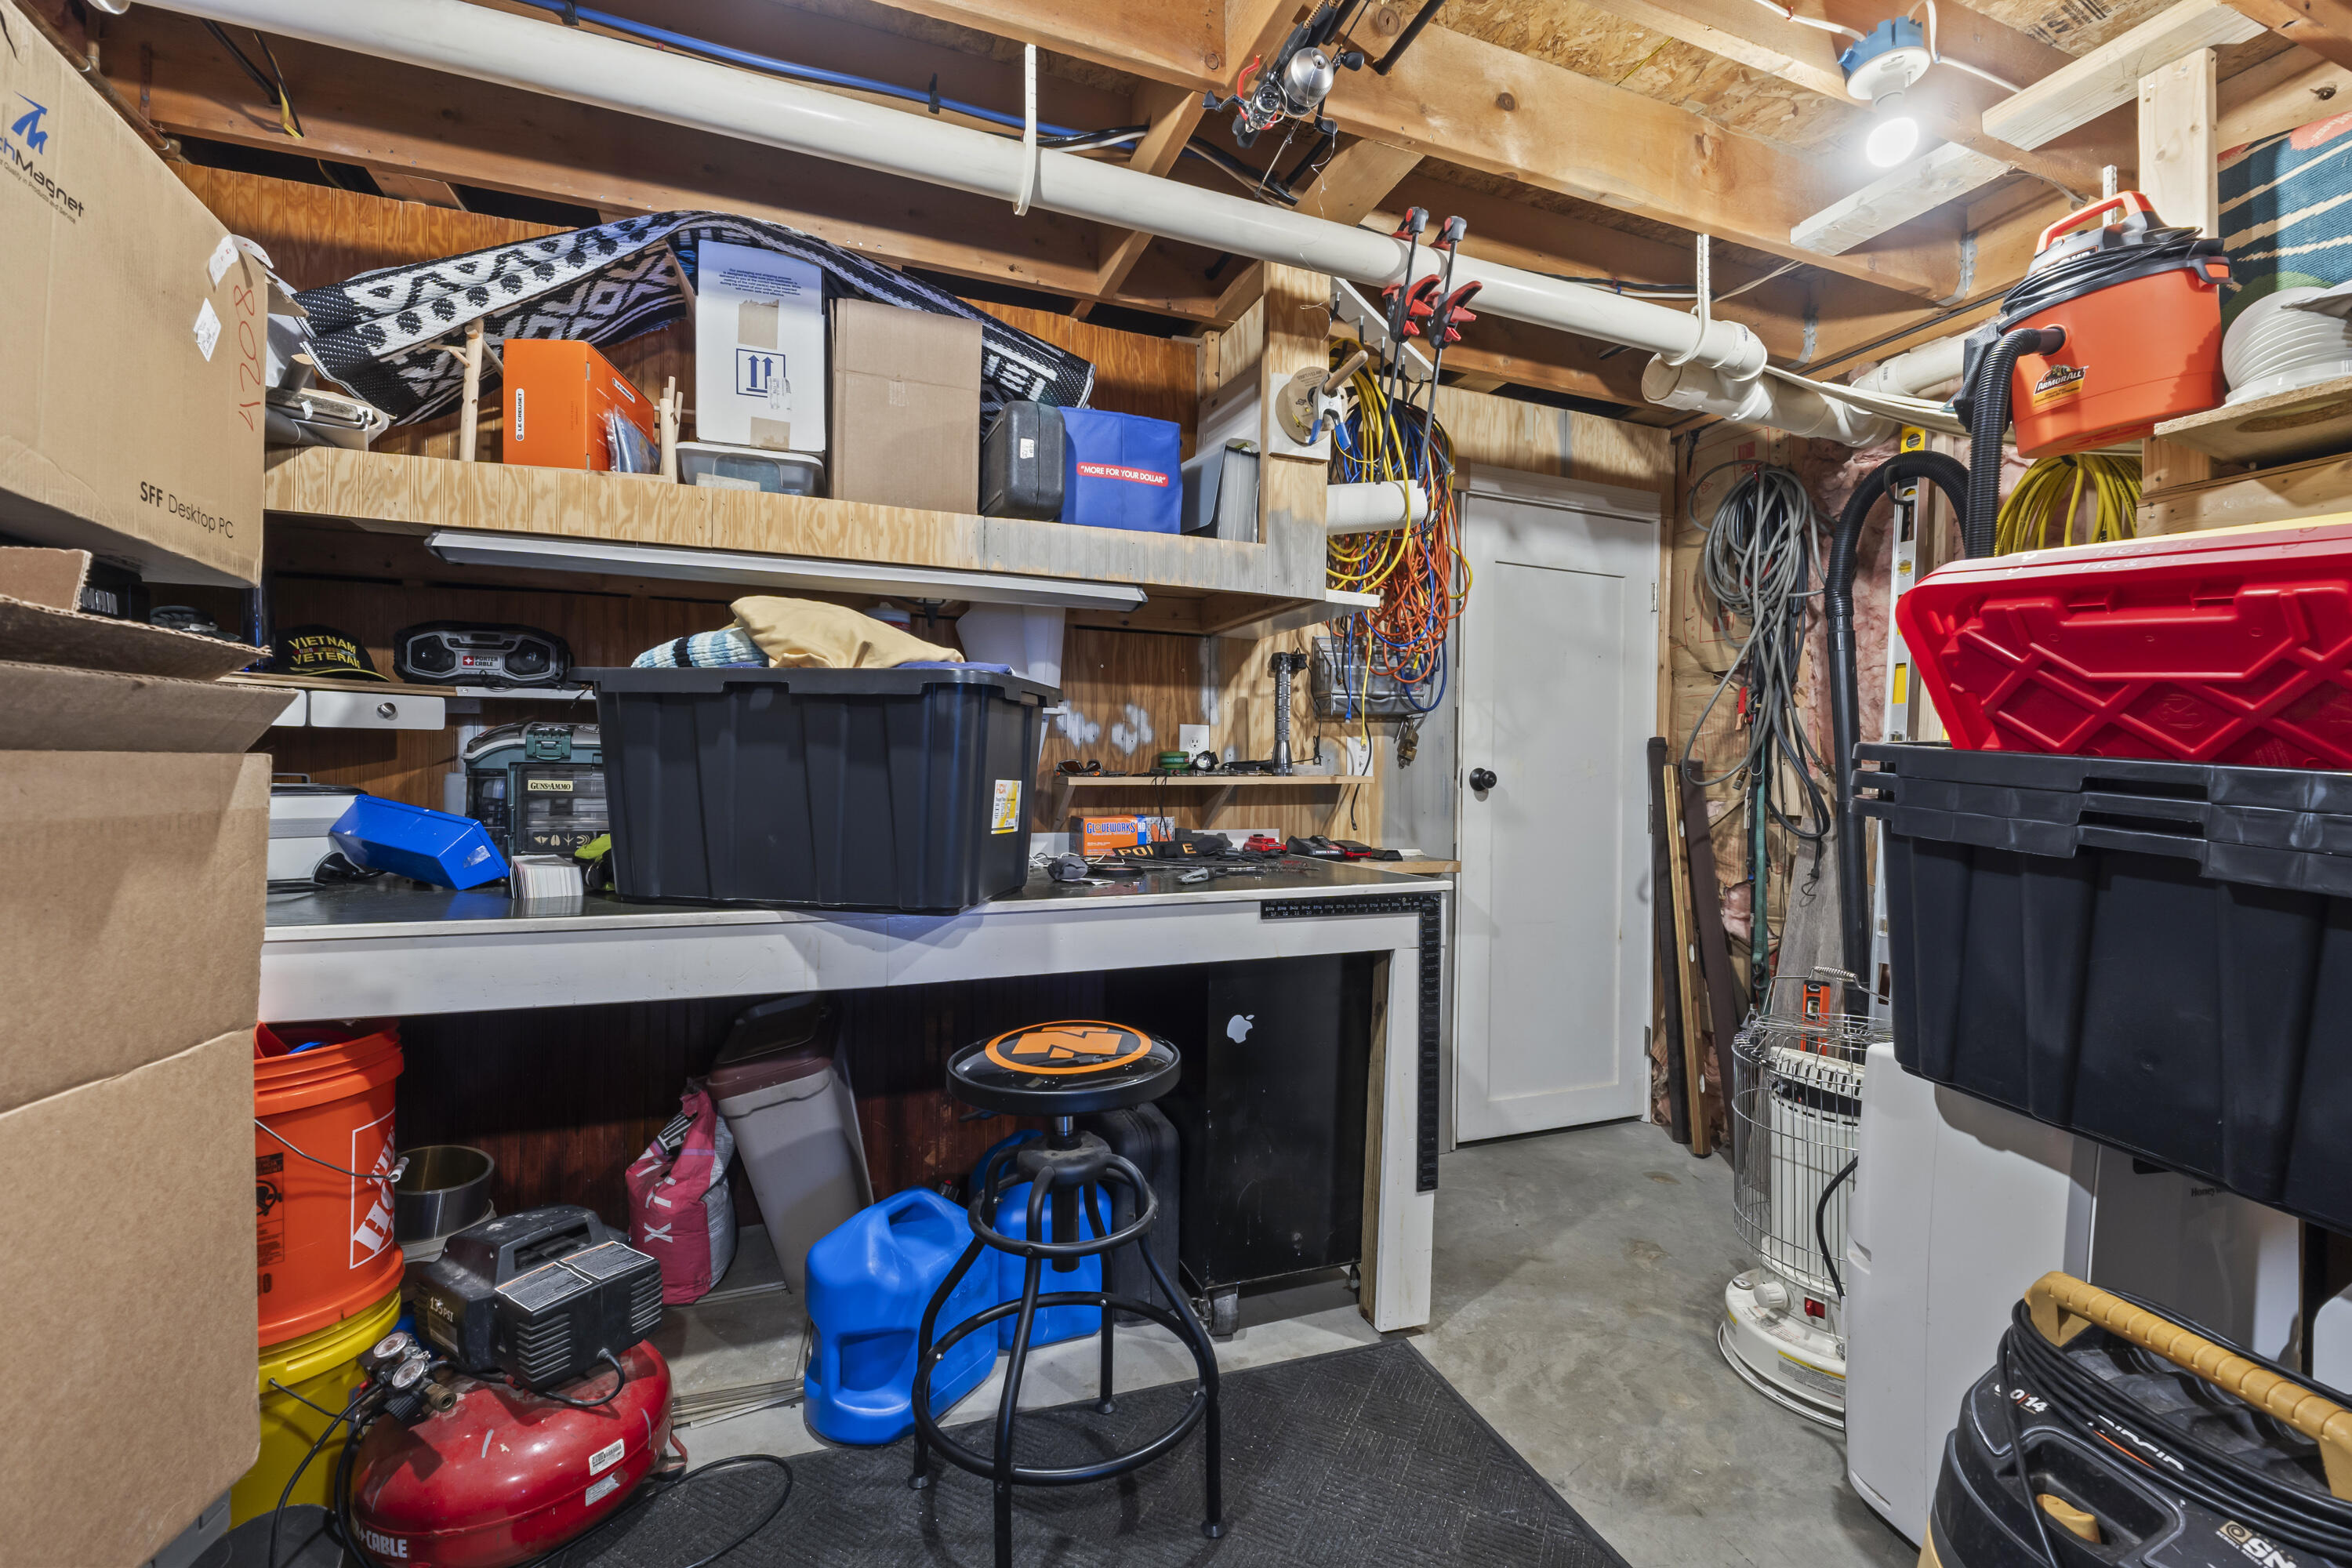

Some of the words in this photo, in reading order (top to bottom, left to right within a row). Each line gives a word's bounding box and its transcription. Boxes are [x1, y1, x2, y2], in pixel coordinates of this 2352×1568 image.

[0, 136, 85, 217] hMagnet
[518, 422, 522, 432] LE
[1105, 468, 1120, 477] FOR
[1121, 469, 1139, 480] YOUR
[140, 481, 163, 507] SFF
[169, 493, 216, 533] Desktop
[219, 517, 234, 539] PC
[288, 635, 357, 655] VIETNAM
[291, 651, 361, 670] VETERAN
[1138, 822, 1146, 833] HD
[444, 1307, 454, 1323] PSI
[2024, 1396, 2048, 1413] 14
[365, 1530, 408, 1559] CABLE
[2215, 1530, 2240, 1550] SCROLL
[2241, 1548, 2263, 1566] NOISE
